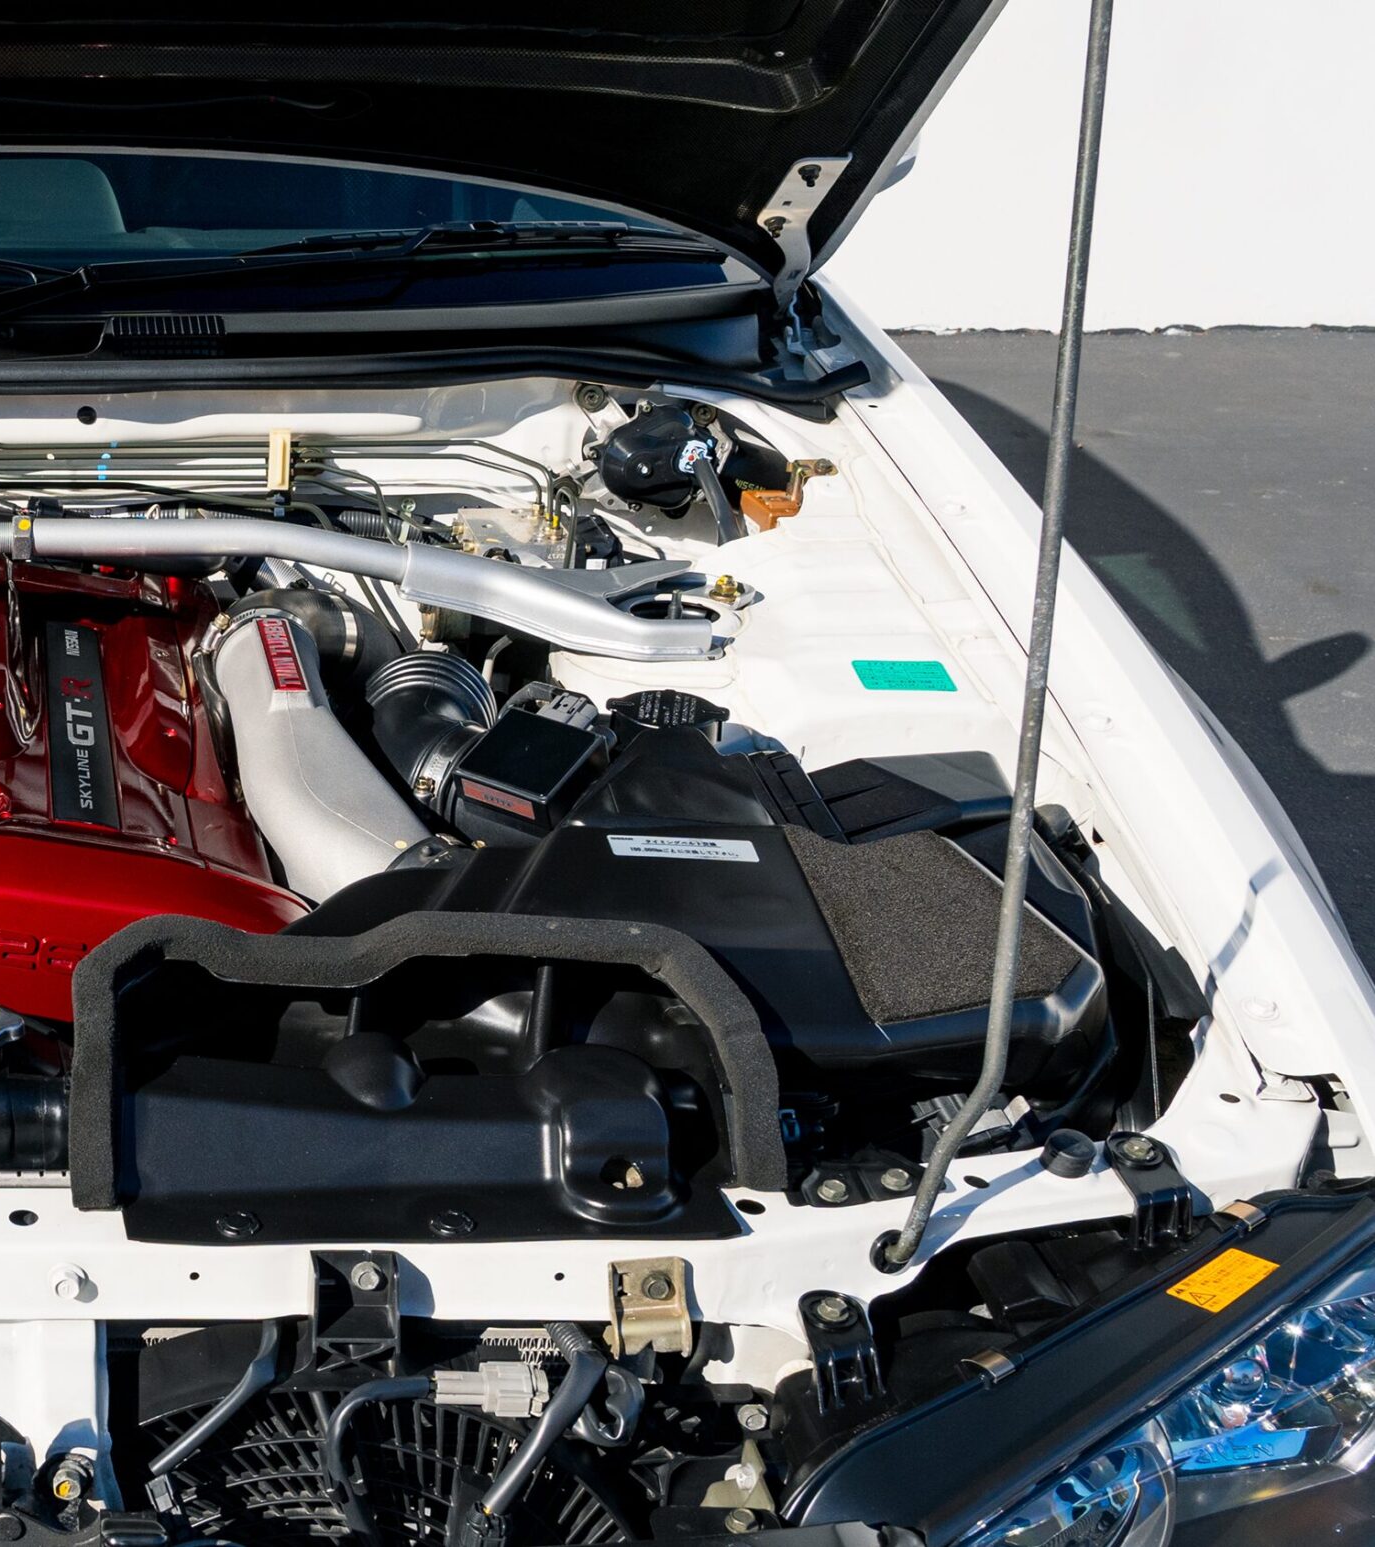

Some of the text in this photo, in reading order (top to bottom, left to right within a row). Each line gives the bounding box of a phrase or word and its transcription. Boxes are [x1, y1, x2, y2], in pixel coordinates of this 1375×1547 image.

[64, 629, 81, 657] NISSAN
[262, 618, 302, 688] TWIN TURBO
[76, 749, 93, 810] SKYLINE
